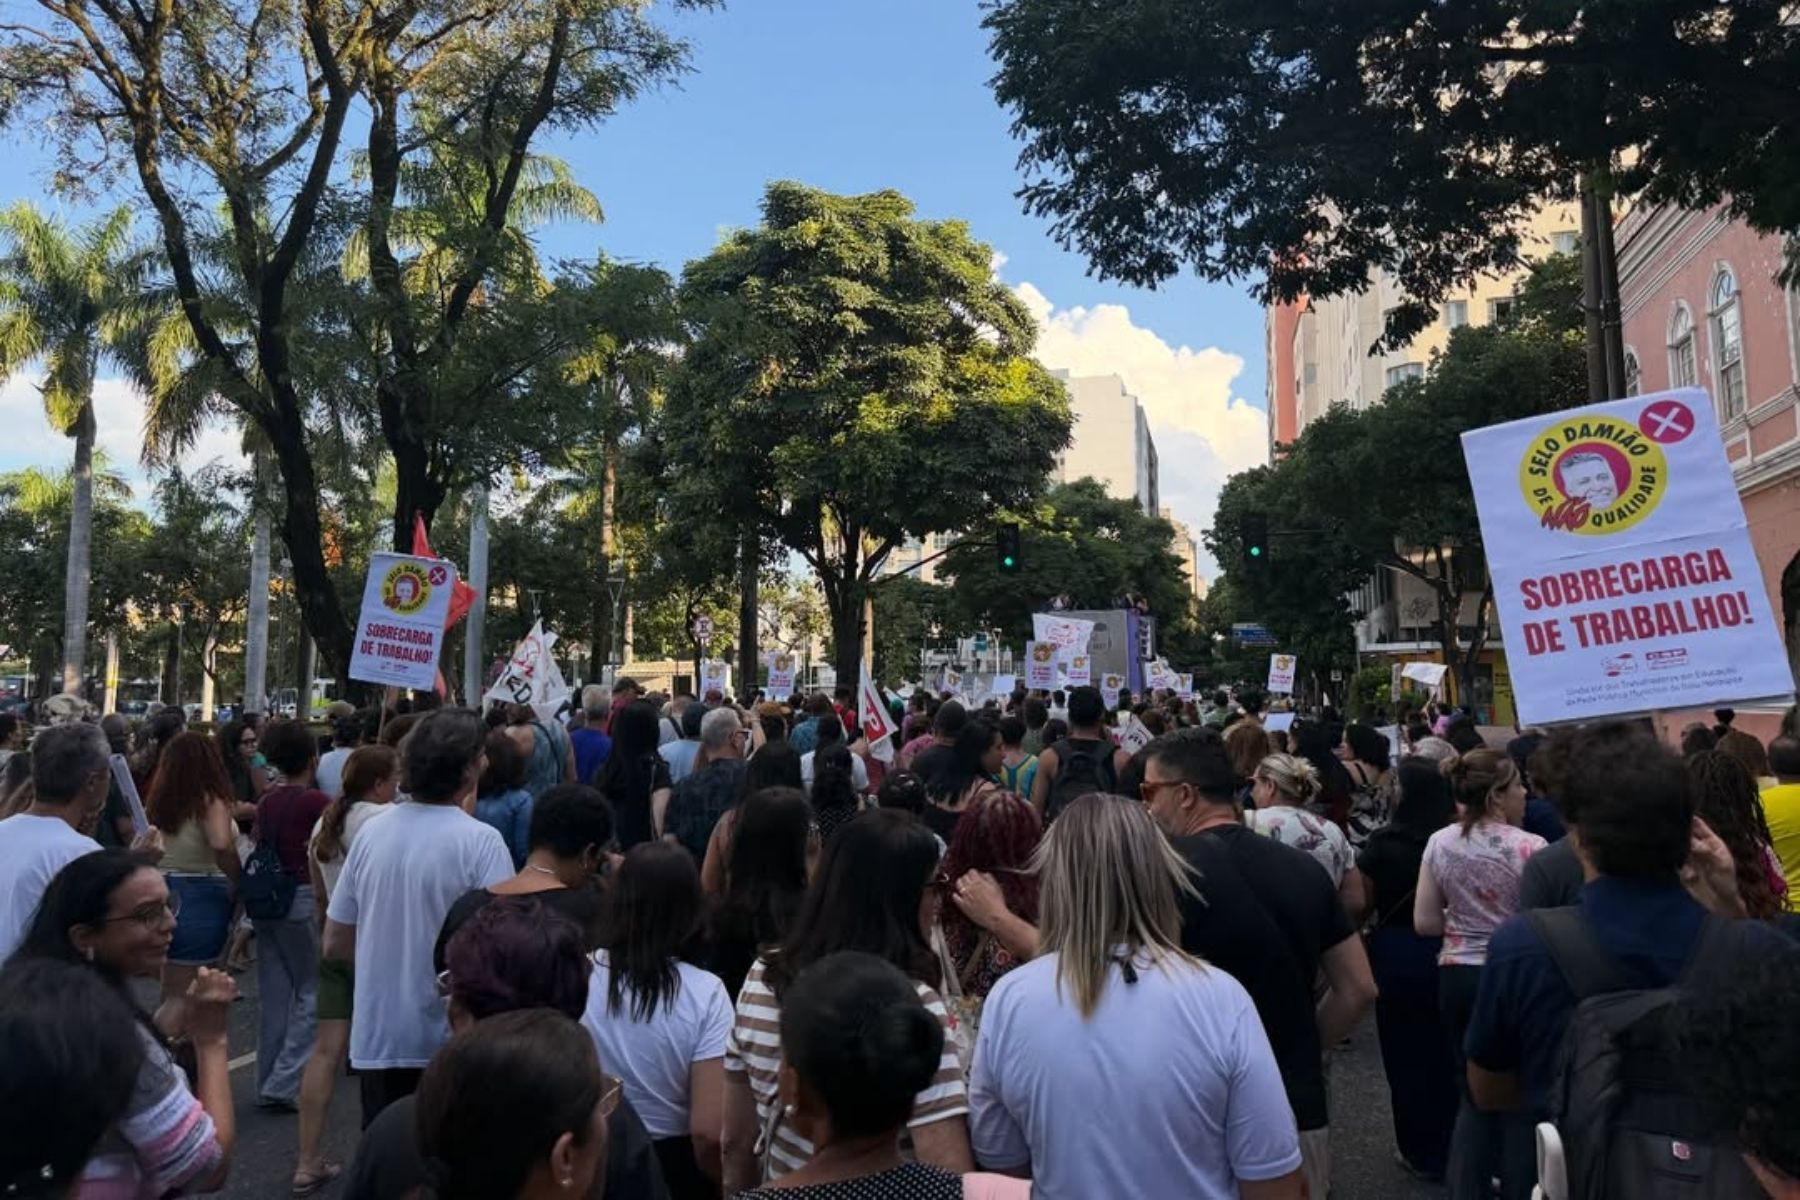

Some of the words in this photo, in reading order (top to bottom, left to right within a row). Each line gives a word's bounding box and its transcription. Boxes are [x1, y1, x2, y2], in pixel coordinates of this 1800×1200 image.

[1528, 438, 1560, 477] SELO
[1563, 423, 1649, 456] DAMIÃO
[1533, 487, 1554, 506] DE
[1541, 496, 1591, 532] NÃO
[1591, 465, 1656, 527] QUALIDADE
[1519, 548, 1733, 611] SOBRECARGA
[365, 622, 434, 646] SOBRECARGA
[1522, 619, 1566, 656] DE
[1570, 591, 1754, 649] TRABALHO!
[360, 640, 375, 656] DE
[377, 642, 433, 665] TRABALHO!
